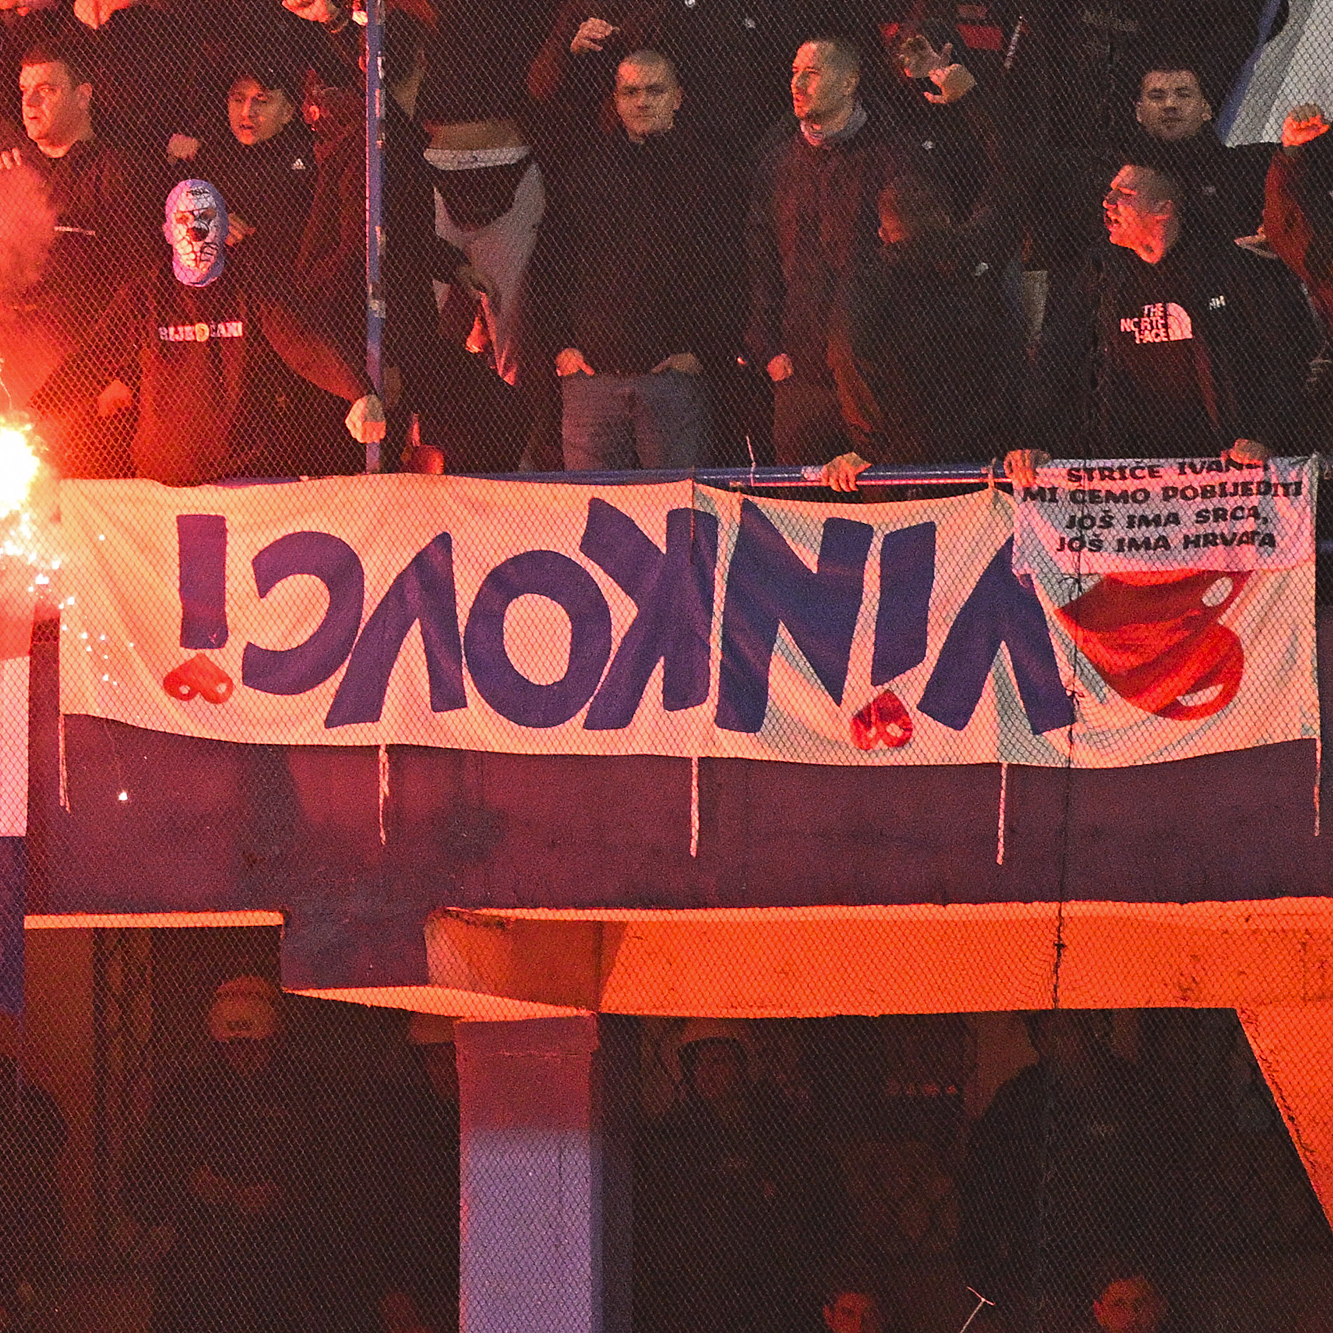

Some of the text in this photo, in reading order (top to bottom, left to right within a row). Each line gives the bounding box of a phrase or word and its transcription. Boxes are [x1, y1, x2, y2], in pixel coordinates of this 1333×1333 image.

[1143, 302, 1165, 317] THE
[1134, 328, 1170, 344] FACE
[1022, 486, 1059, 504] MI
[1161, 480, 1303, 503] POBIJEDITI
[1125, 512, 1181, 529] IMA
[1115, 534, 1172, 553] IMA
[1182, 530, 1276, 550] HRVATA
